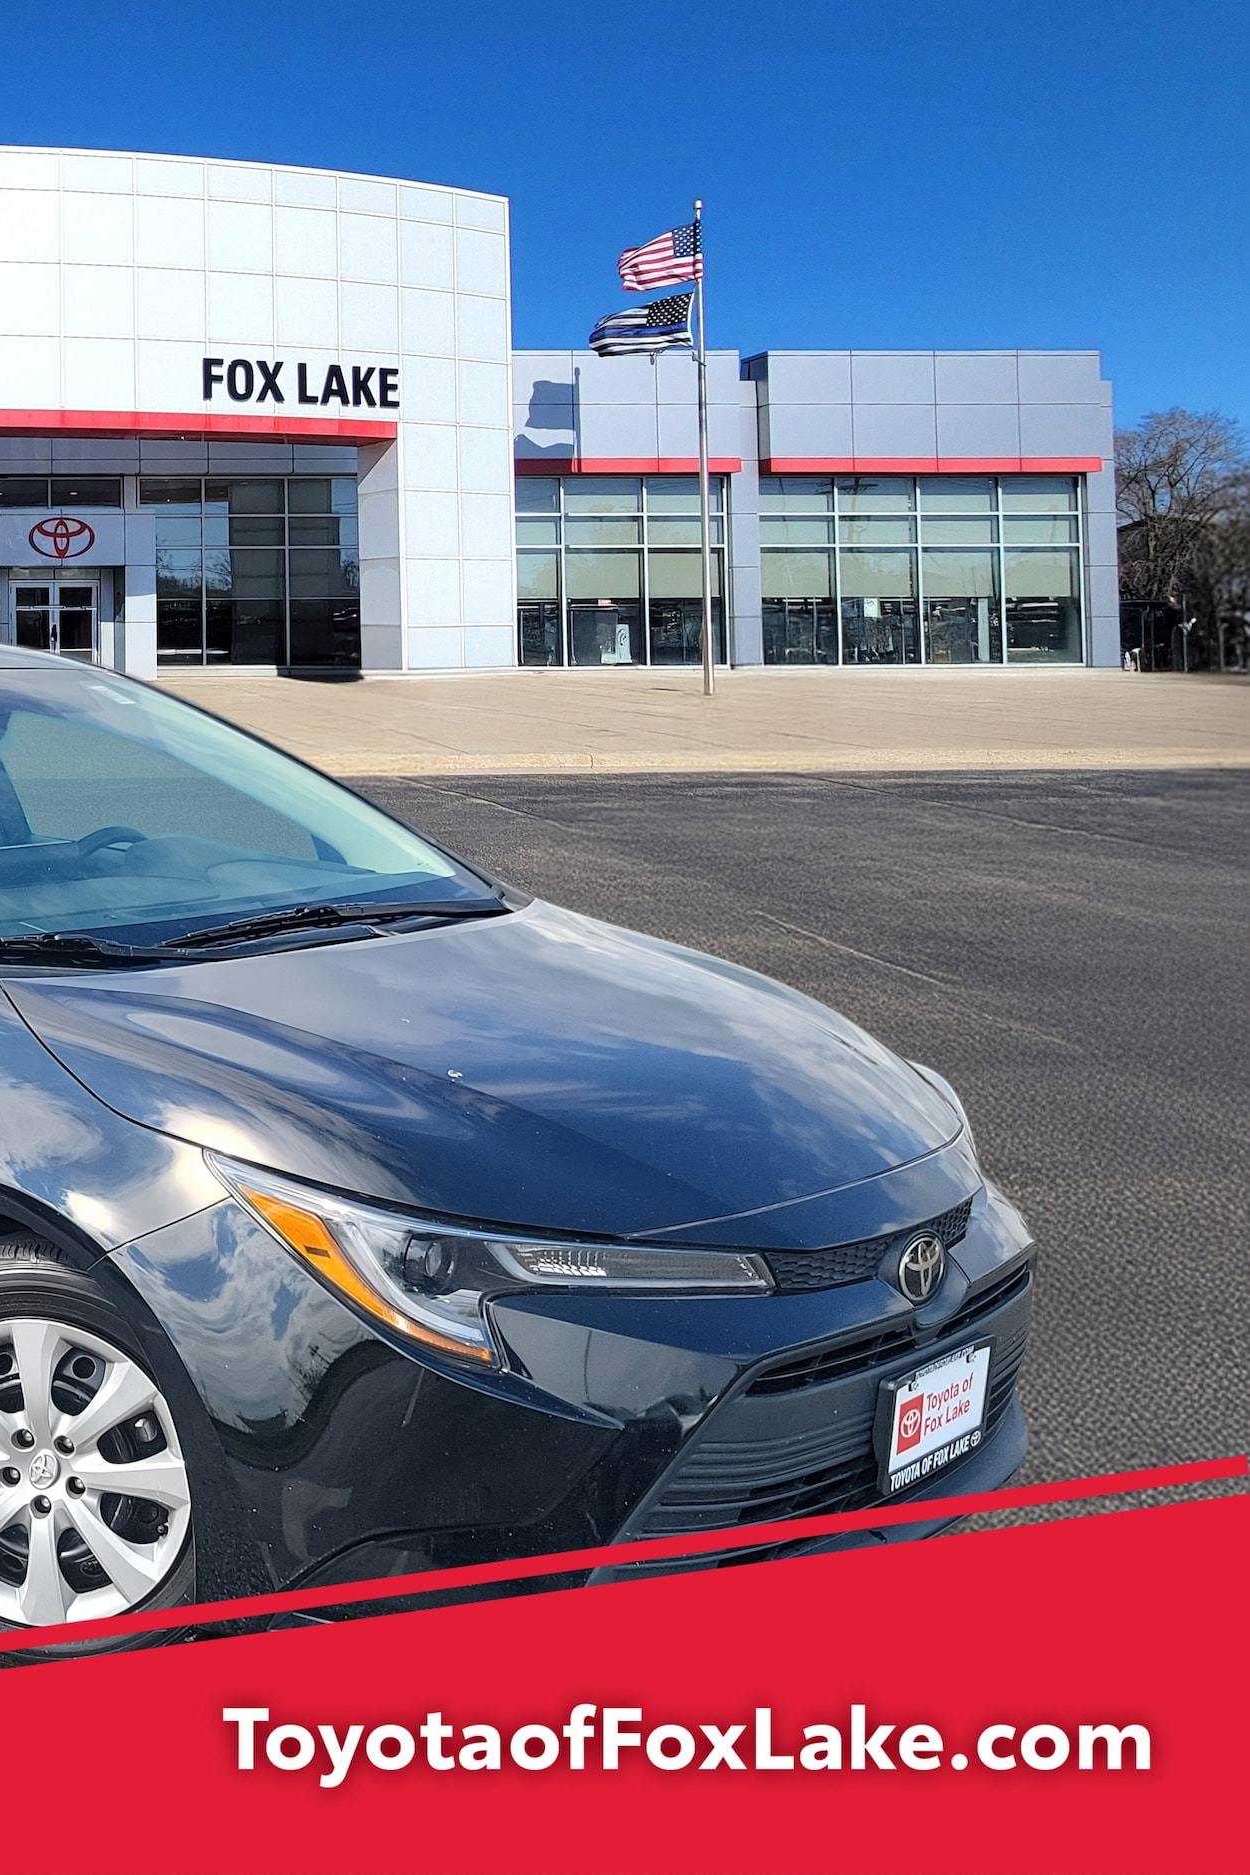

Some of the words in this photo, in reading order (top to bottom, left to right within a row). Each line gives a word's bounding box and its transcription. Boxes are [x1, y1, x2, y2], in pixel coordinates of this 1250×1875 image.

[202, 357, 284, 403] FOX
[297, 362, 400, 408] LAKE
[926, 1383, 959, 1411] Toyota
[962, 1372, 974, 1393] of
[924, 1414, 943, 1437] Fox
[946, 1400, 970, 1424] Lake
[890, 1463, 920, 1492] TOYOTA
[921, 1456, 933, 1476] OF
[933, 1446, 950, 1469] FOX
[949, 1435, 970, 1460] LAKE
